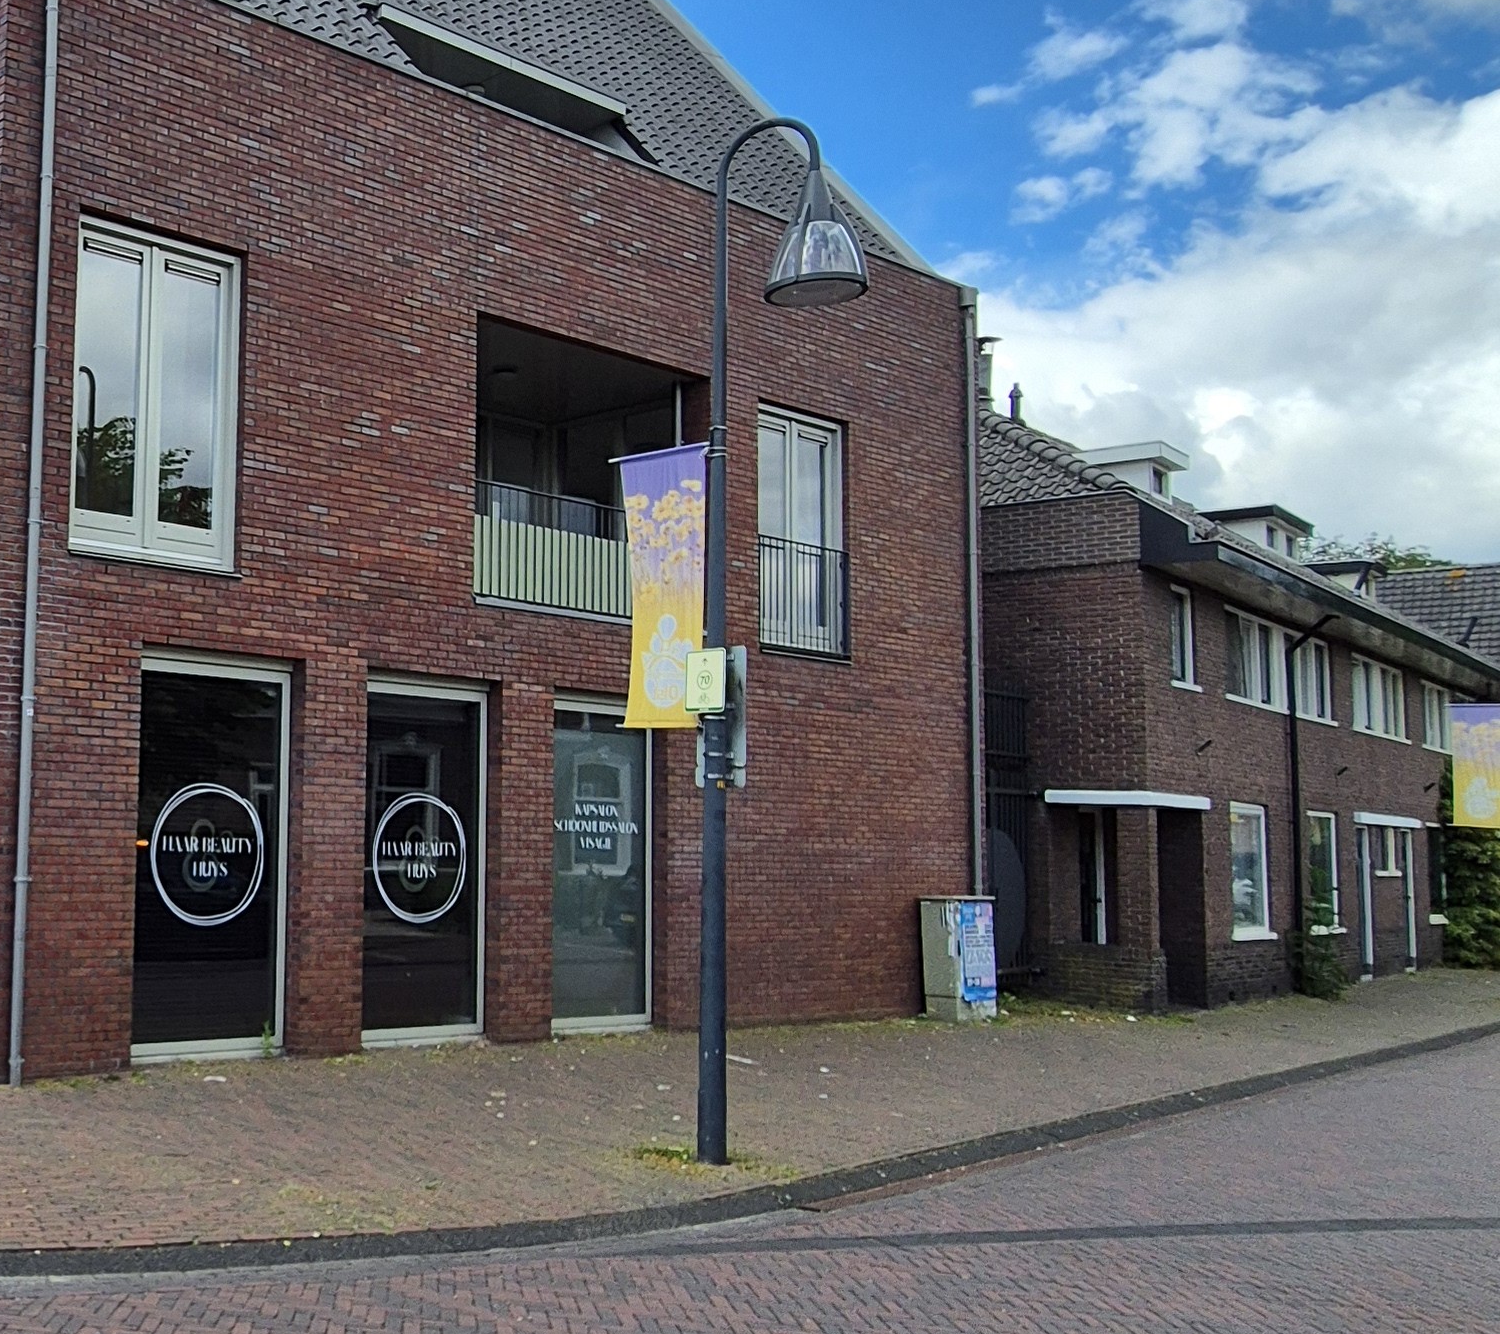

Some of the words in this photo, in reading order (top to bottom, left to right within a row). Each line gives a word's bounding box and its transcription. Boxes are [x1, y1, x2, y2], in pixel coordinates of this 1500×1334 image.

[700, 675, 711, 686] 70
[575, 802, 618, 817] KAPSALON
[162, 835, 199, 853] HAAR
[202, 836, 253, 854] BEAUTY
[382, 841, 412, 857] HAAR
[414, 841, 457, 857] BEAUTY
[192, 860, 229, 878] HUYS
[407, 862, 437, 879] HUYS
